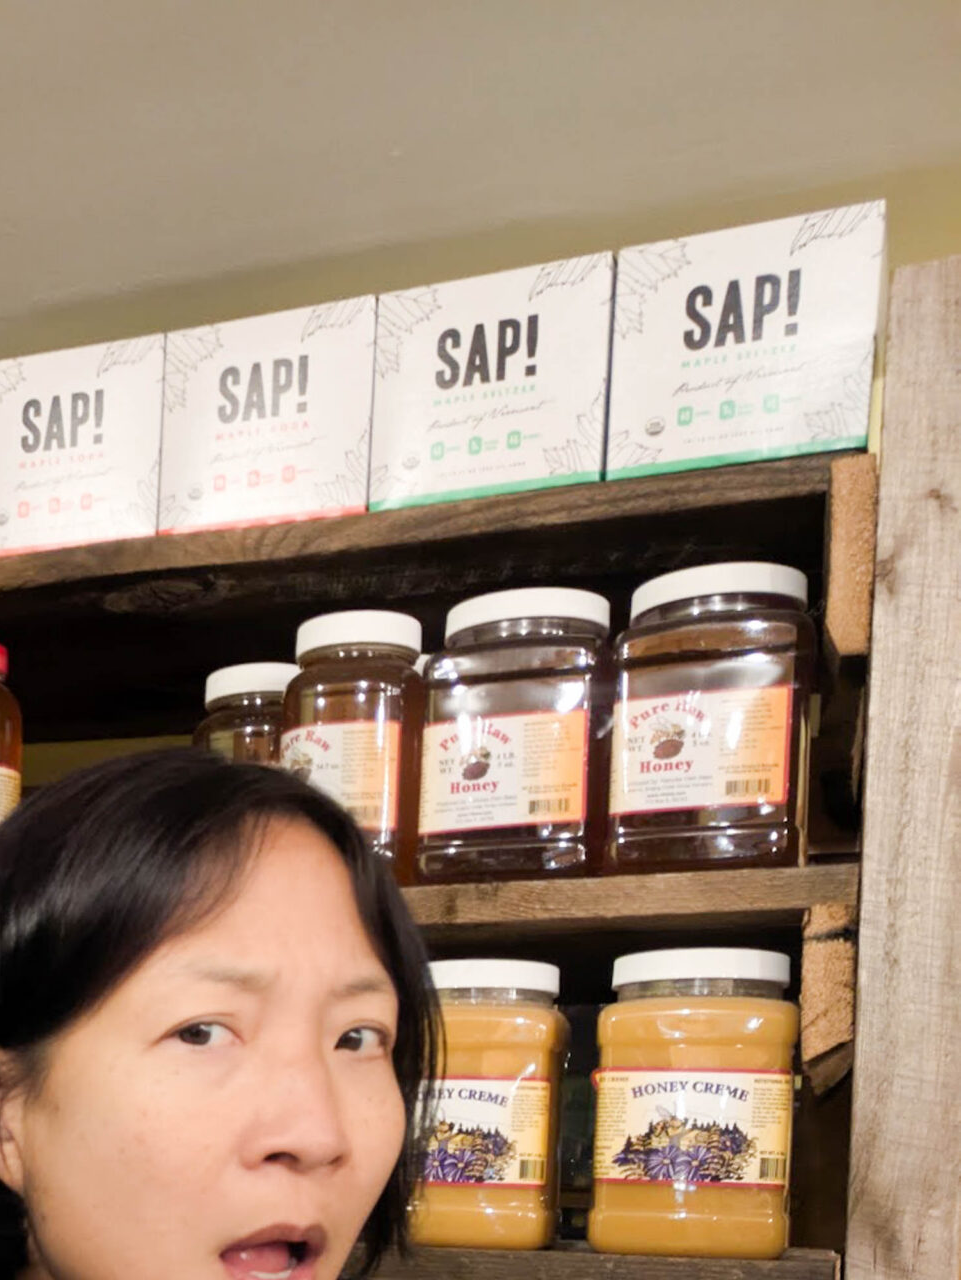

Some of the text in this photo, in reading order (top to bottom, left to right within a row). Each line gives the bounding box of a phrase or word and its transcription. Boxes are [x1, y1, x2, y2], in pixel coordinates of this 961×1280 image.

[683, 268, 801, 351] SAP!
[435, 314, 539, 390] SAP!
[217, 355, 309, 424] SAP!
[21, 389, 104, 454] SAP!
[629, 701, 670, 730] Pure
[639, 759, 695, 775] Honey
[449, 780, 500, 796] Honey
[457, 1087, 509, 1108] CREME
[631, 1079, 750, 1103] HONEY CREME
